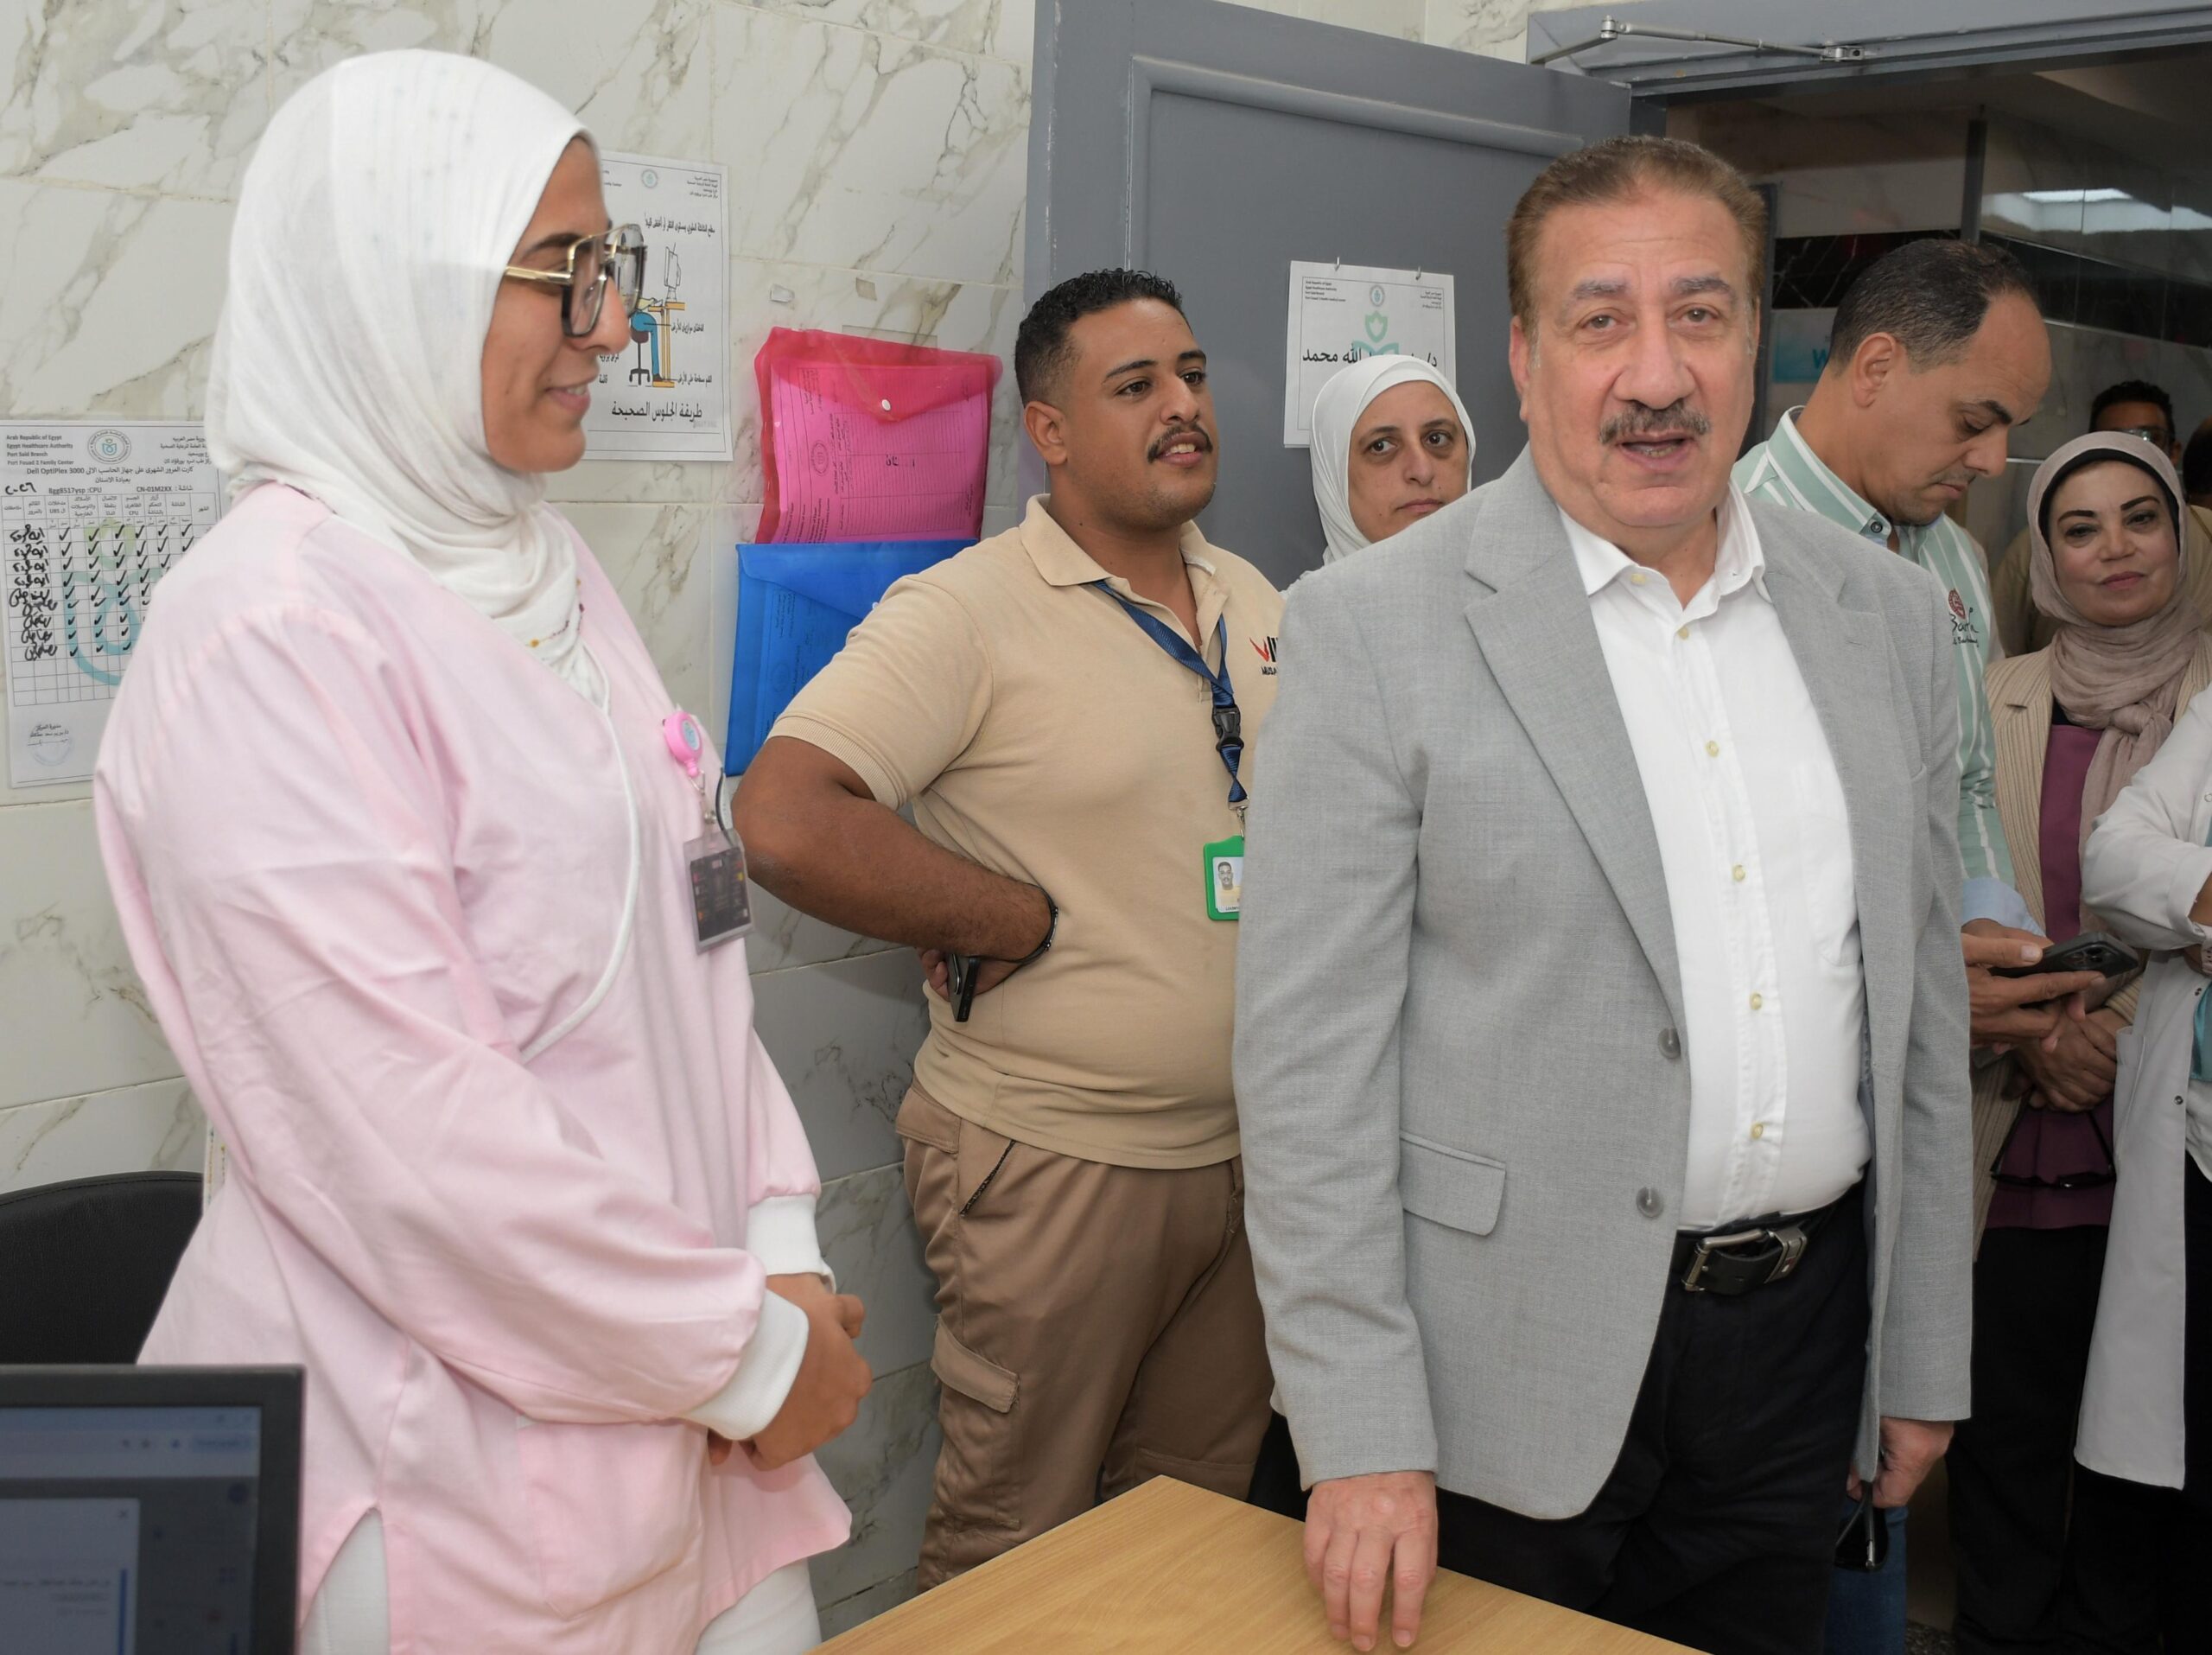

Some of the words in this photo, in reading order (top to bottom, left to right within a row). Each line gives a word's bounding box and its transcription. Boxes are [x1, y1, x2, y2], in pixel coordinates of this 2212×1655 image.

[1303, 348, 1338, 363] محمد
[611, 401, 650, 420] الصحيحة
[652, 401, 677, 422] الجلوس
[679, 402, 702, 422] طريقة
